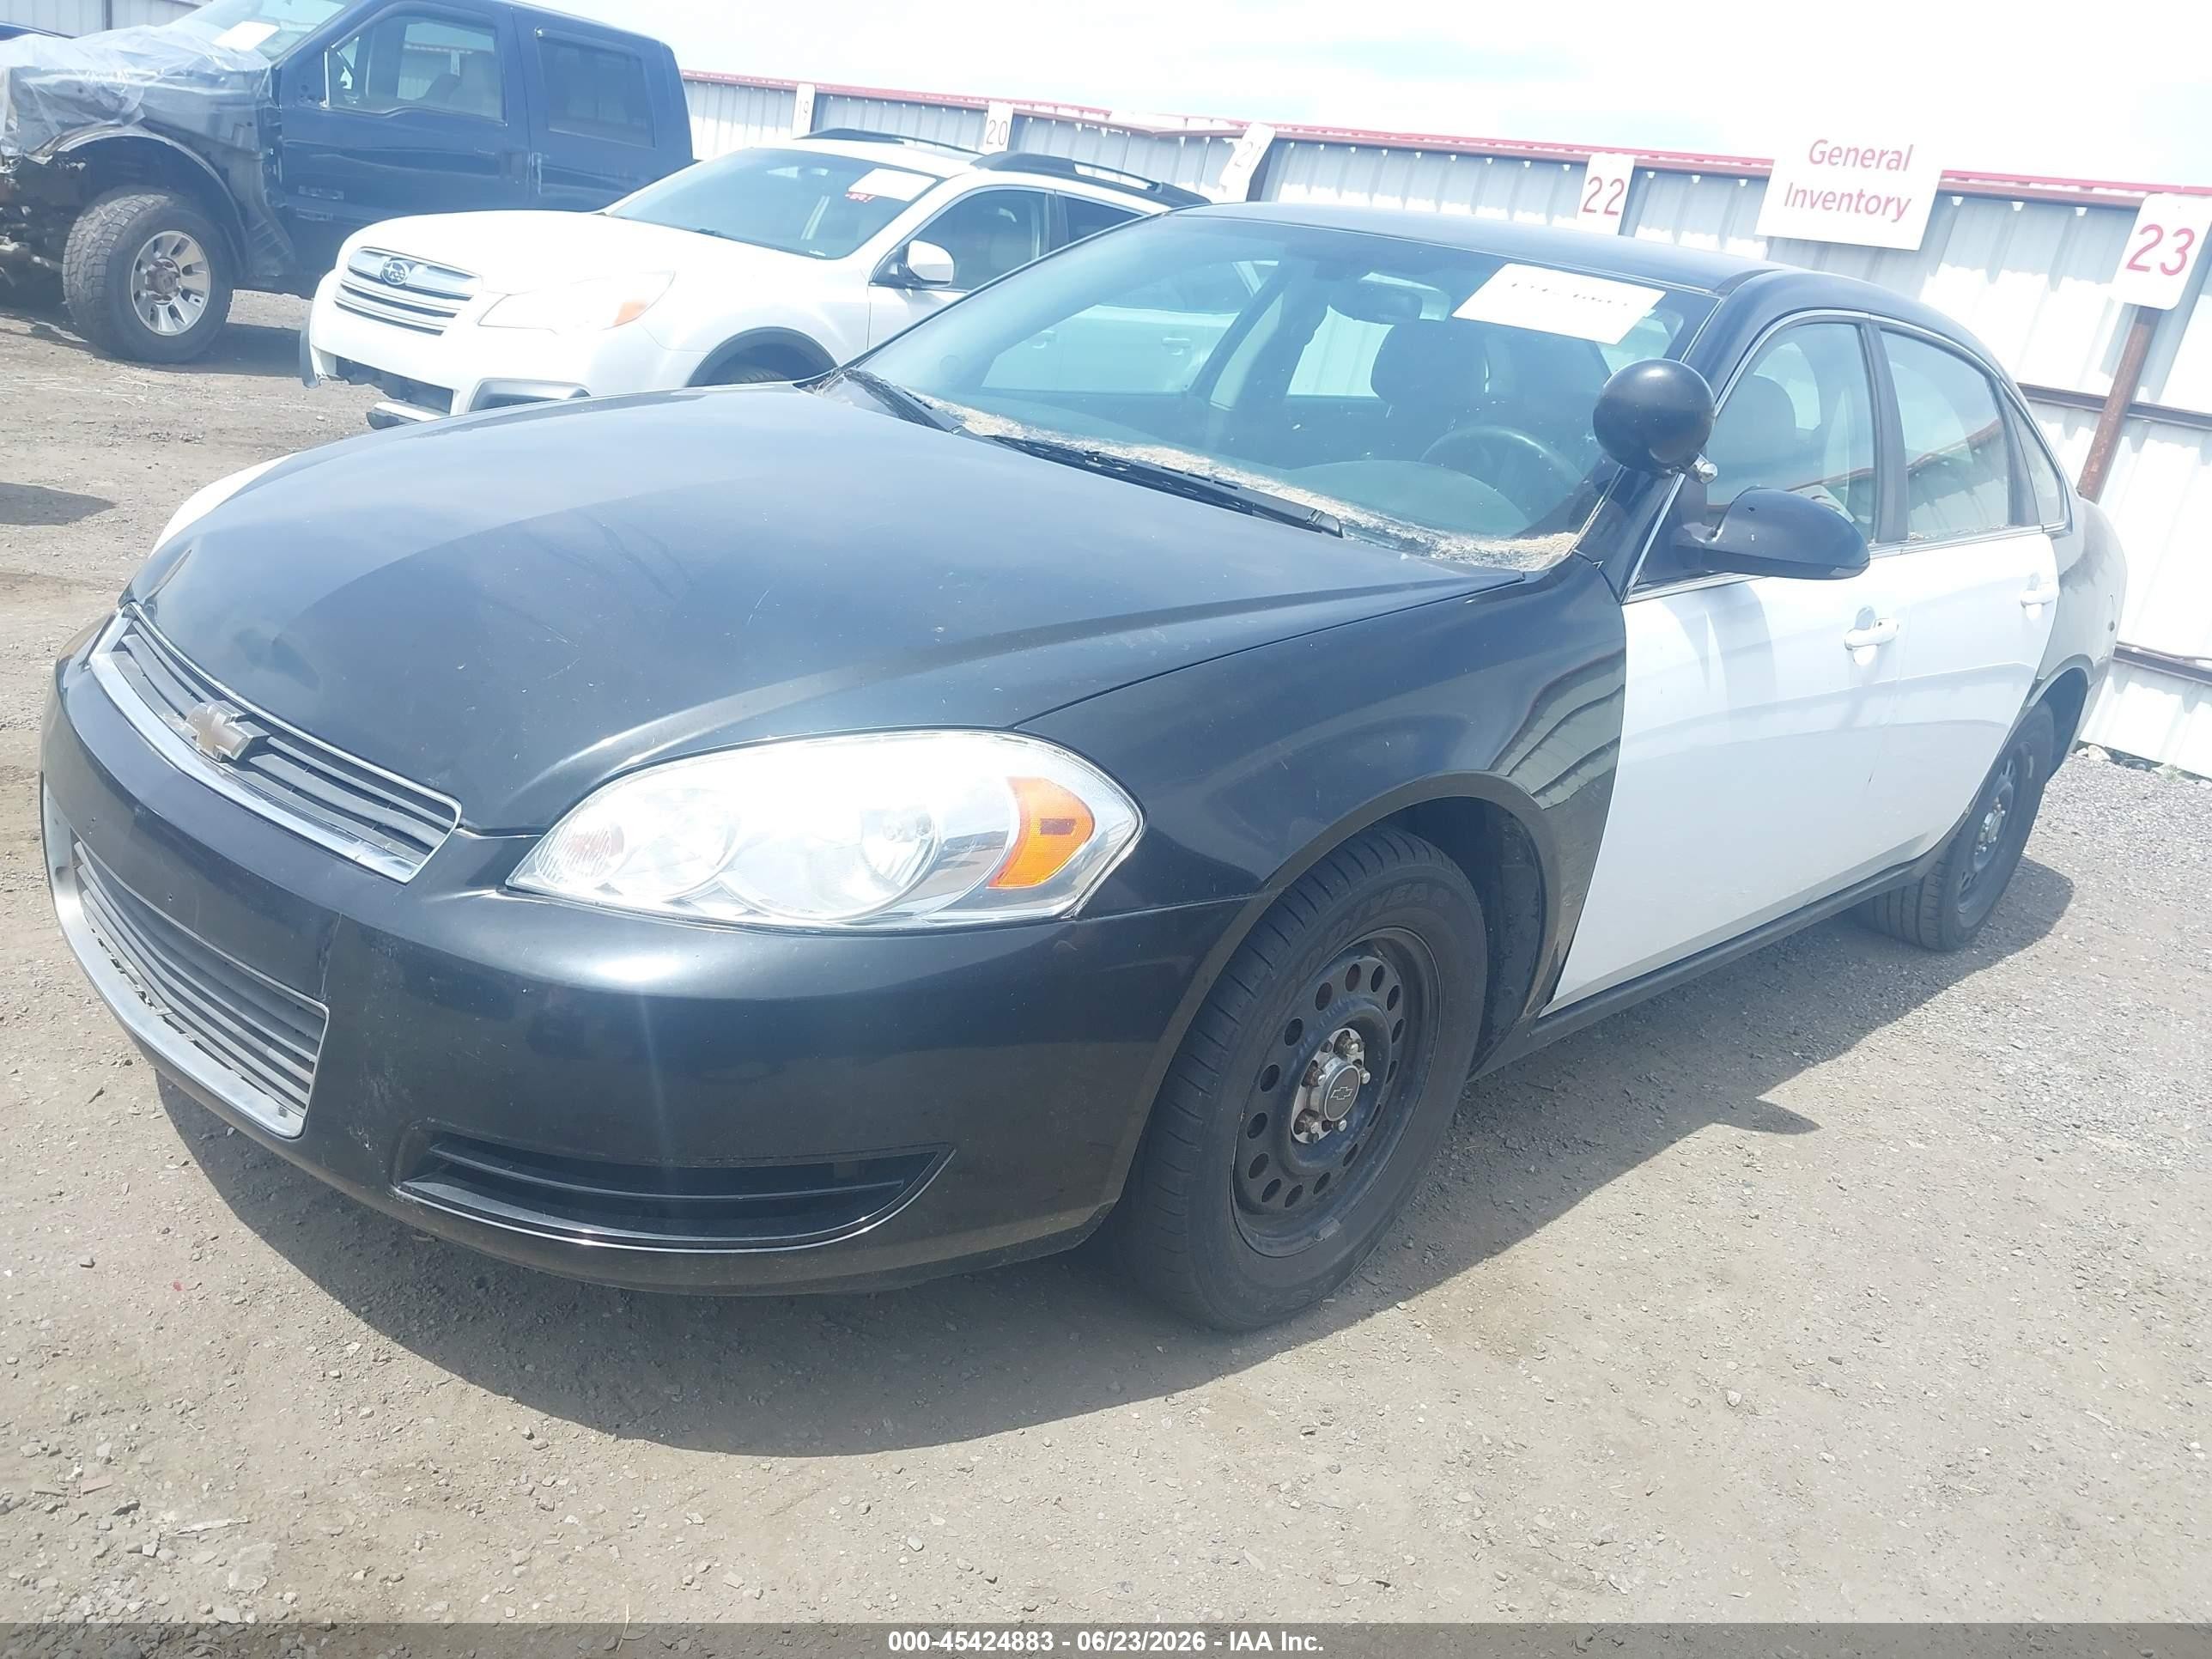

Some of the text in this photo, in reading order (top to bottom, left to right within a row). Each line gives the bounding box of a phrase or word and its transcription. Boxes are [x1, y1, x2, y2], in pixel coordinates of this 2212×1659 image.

[986, 118, 1008, 146] 20
[1808, 138, 1914, 172] General
[1582, 175, 1626, 216] 22
[1784, 181, 1912, 223] Inventory
[2125, 223, 2196, 276] 23
